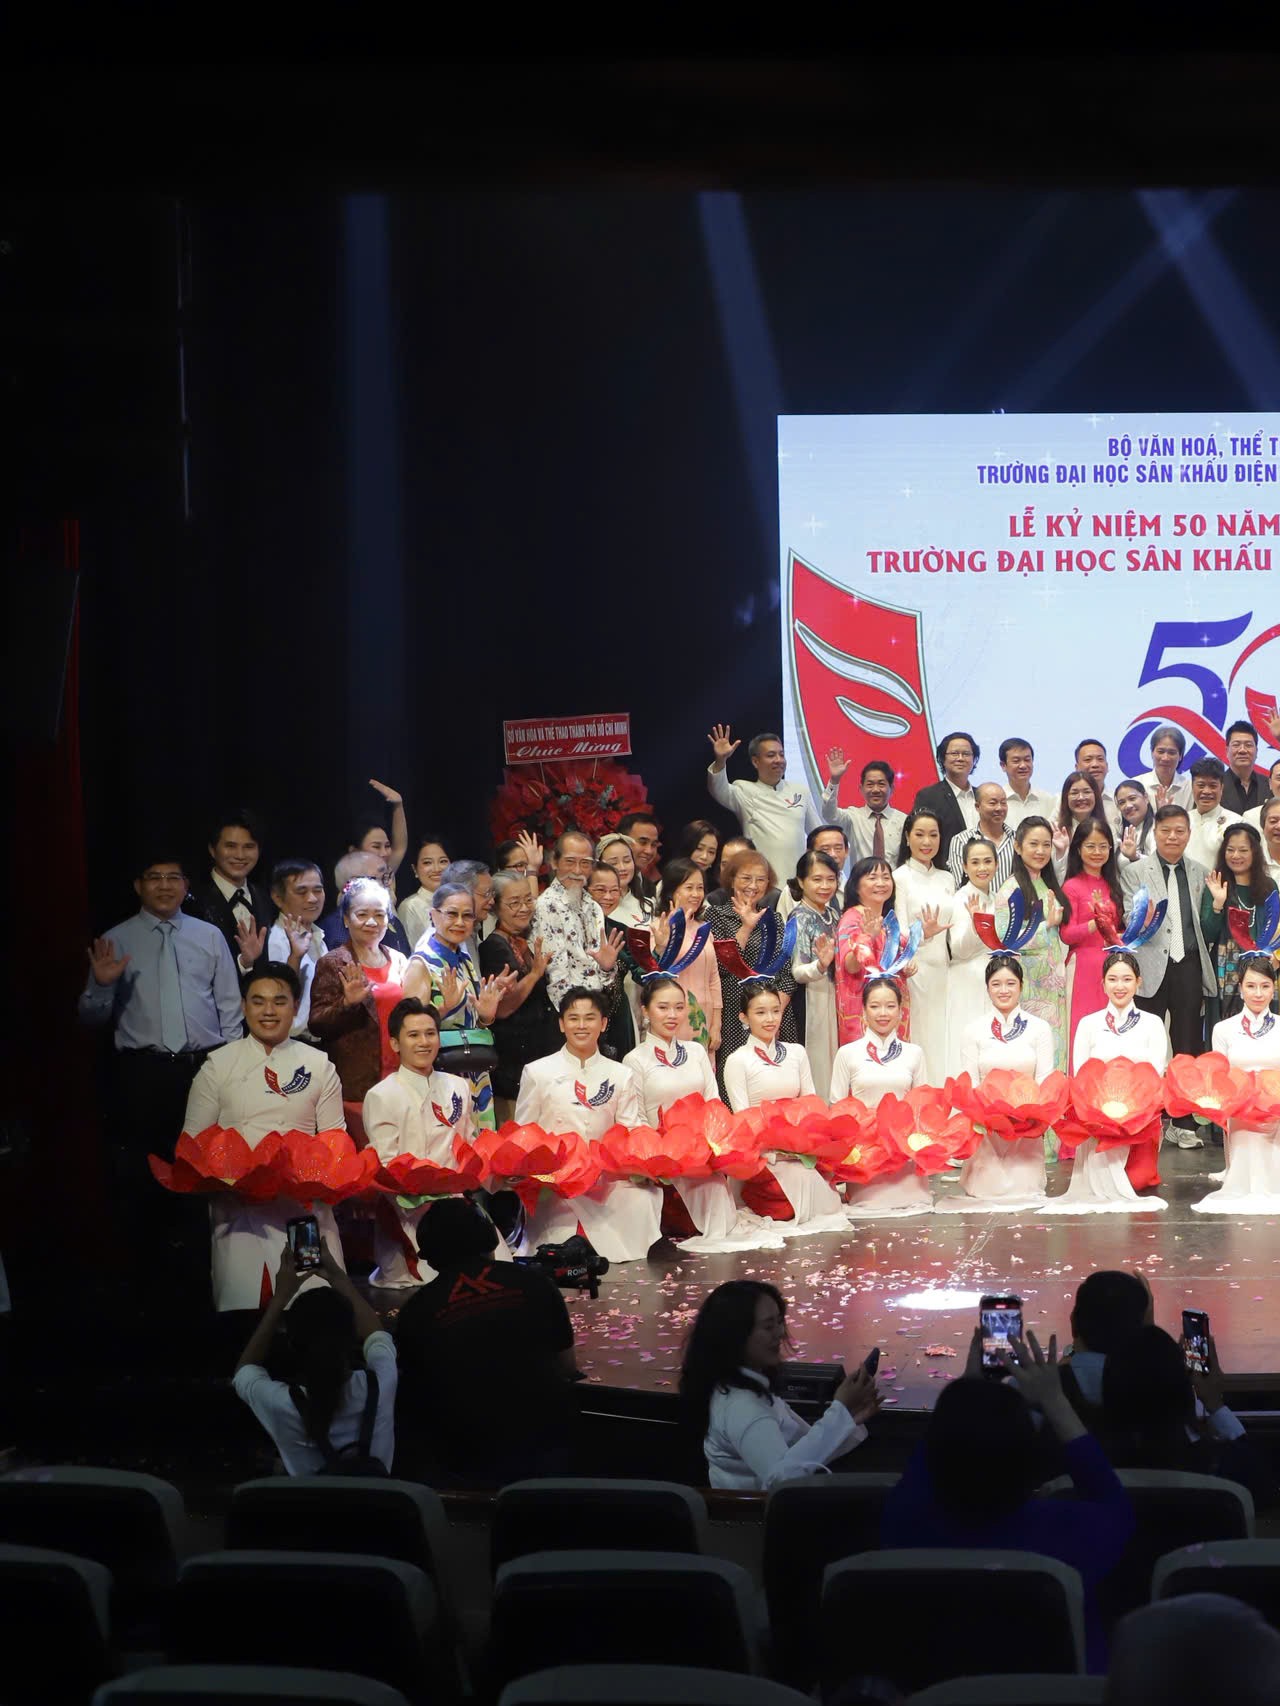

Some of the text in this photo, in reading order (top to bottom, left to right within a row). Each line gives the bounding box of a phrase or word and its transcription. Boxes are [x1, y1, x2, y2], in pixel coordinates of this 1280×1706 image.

[1108, 433, 1132, 460] BỘ
[1138, 434, 1175, 457] VĂN
[1181, 433, 1223, 460] HOÁ,
[1231, 430, 1262, 456] THỂ
[977, 461, 1049, 485] TRƯỜNG
[1055, 463, 1086, 487] ĐẠI
[1093, 463, 1129, 487] HỌC
[1136, 460, 1173, 484] SÂN
[1180, 458, 1228, 483] KHẤU
[1235, 461, 1277, 486] ĐIỆN
[1009, 505, 1036, 538] LỄ
[1046, 507, 1083, 537] KỶ
[1093, 510, 1161, 543] NIỆM
[1174, 513, 1207, 537] 50
[1217, 510, 1280, 537] NĂM
[867, 545, 987, 573] TRƯỜNG
[997, 549, 1044, 578] ĐẠI
[1055, 549, 1114, 578] HỌC
[1126, 544, 1182, 572] SÂN
[1193, 541, 1272, 571] KHẤU
[555, 725, 568, 740] THAO
[515, 741, 622, 758] Chúc Mừng
